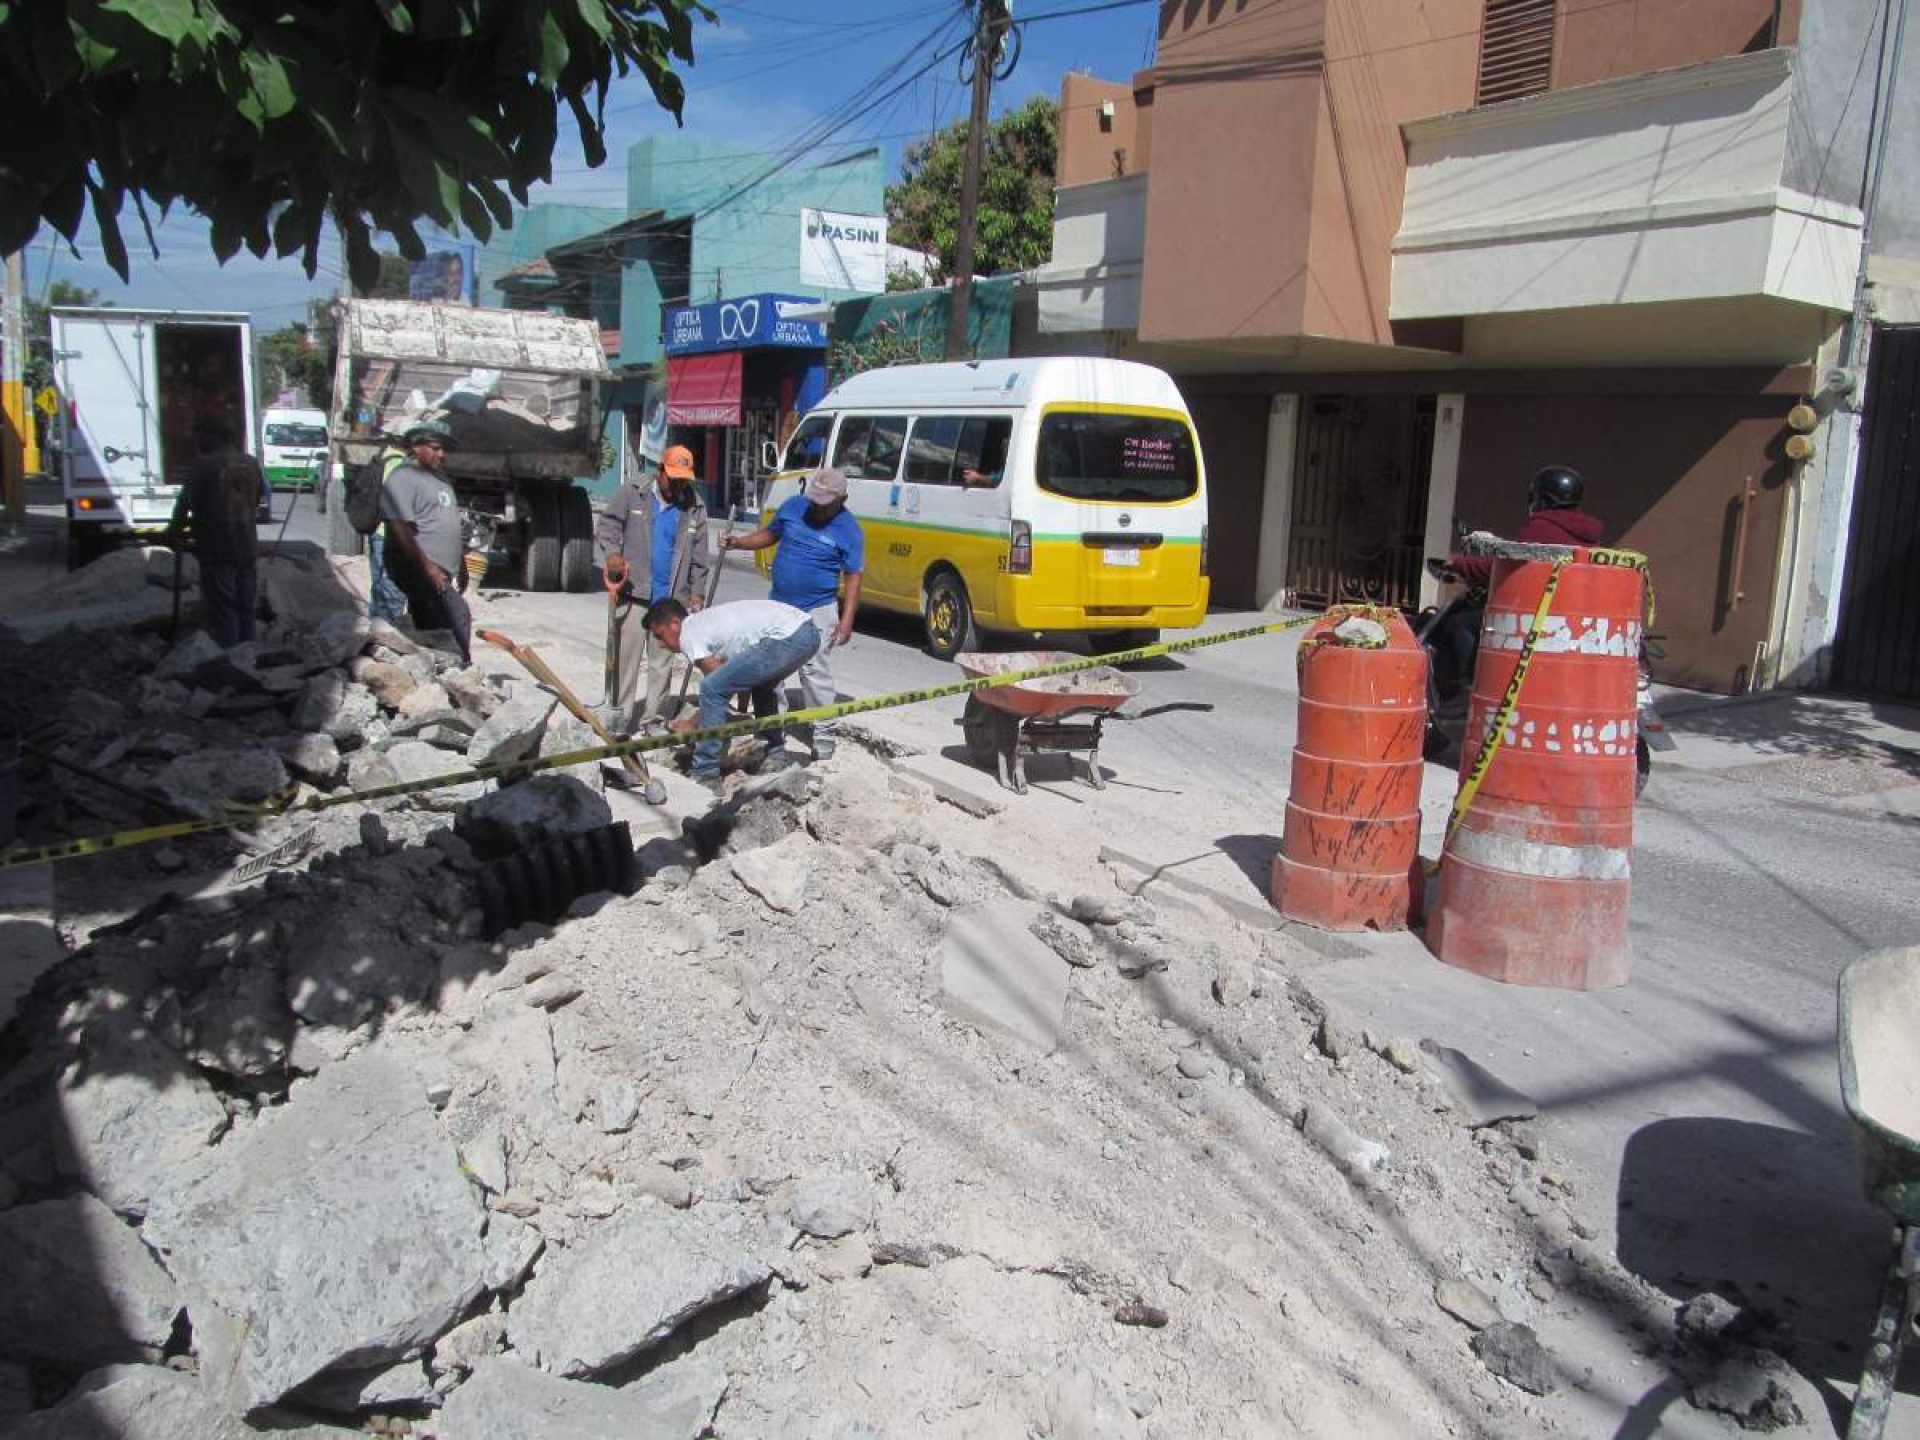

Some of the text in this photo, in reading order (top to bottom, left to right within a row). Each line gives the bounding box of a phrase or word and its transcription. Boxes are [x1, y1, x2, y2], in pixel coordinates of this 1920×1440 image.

[822, 223, 879, 243] PASINI
[673, 326, 703, 343] URBANA
[772, 332, 812, 344] URBANA
